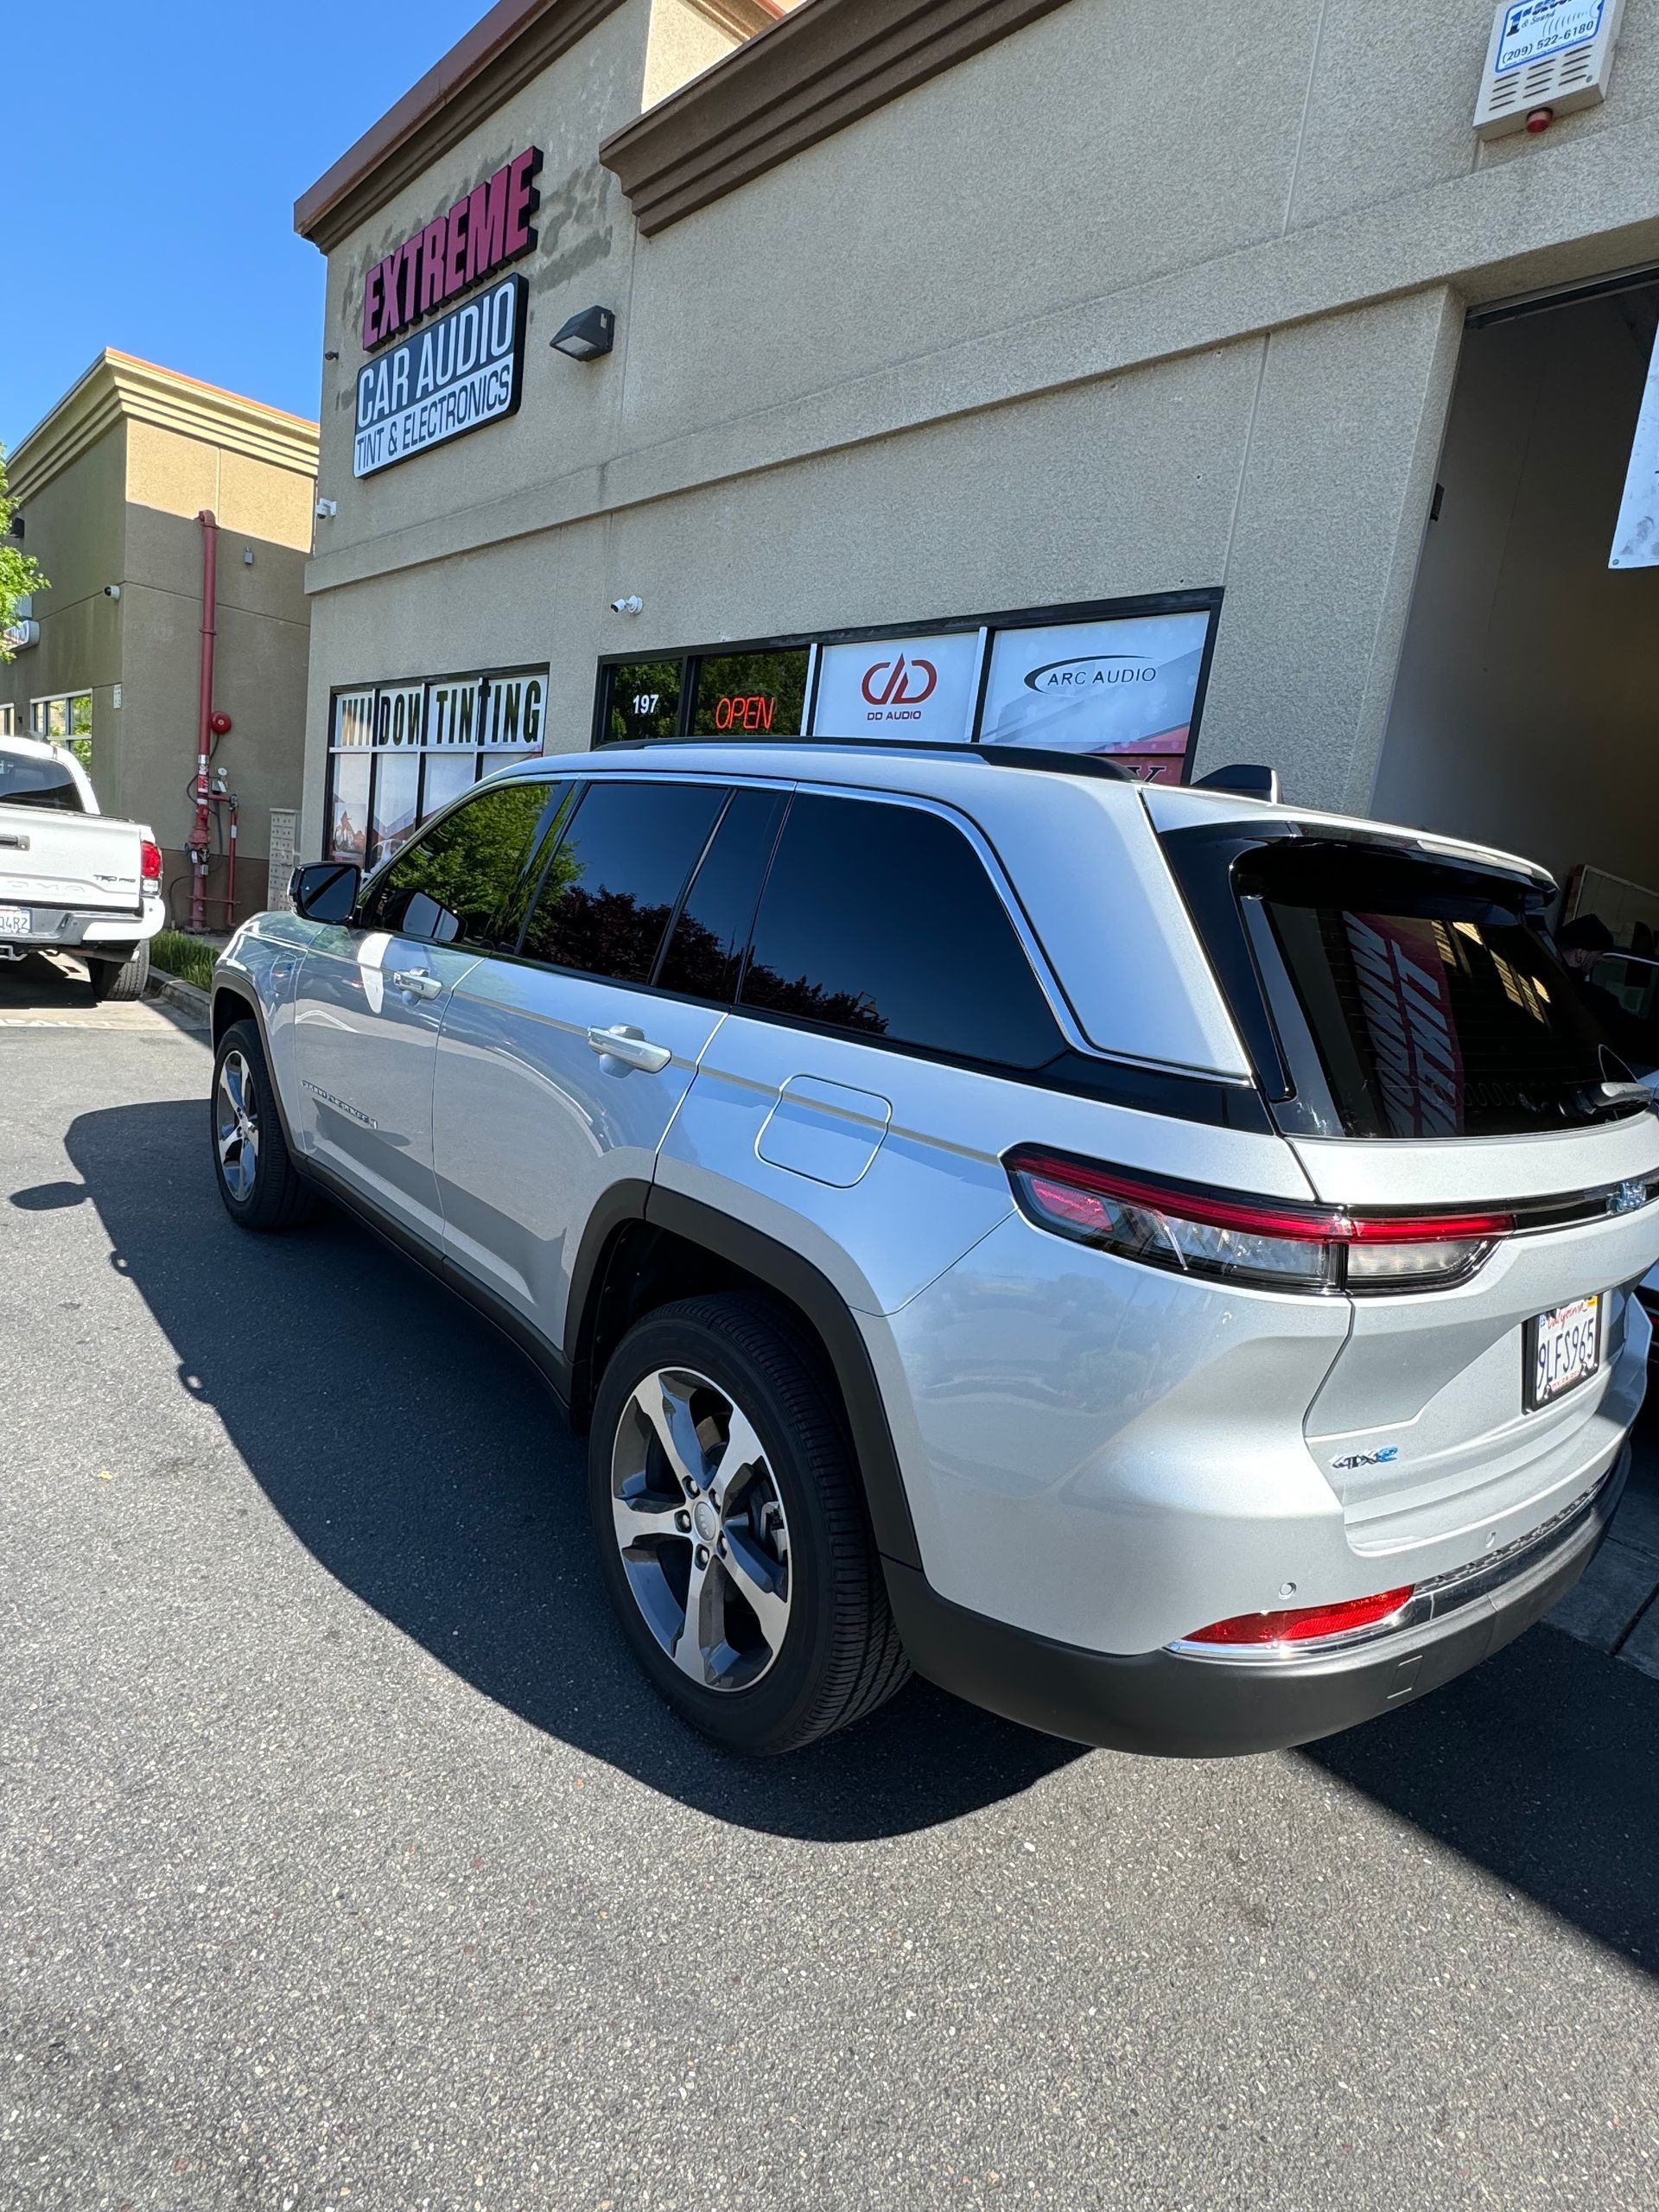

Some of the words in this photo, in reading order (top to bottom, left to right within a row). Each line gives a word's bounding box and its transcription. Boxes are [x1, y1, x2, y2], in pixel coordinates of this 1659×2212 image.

[1530, 10, 1557, 25] Sound
[1502, 43, 1533, 64] (209)
[1536, 20, 1594, 50] 522-6180
[362, 145, 537, 352] EXTREME
[358, 347, 410, 428] CAR
[416, 282, 515, 399] AUDIO
[357, 427, 385, 471] TINT
[388, 421, 397, 456] &
[403, 364, 511, 451] ELECTRONICS
[1047, 672, 1086, 686] ARC
[1092, 667, 1156, 685] AUDIO
[632, 694, 659, 715] 197
[715, 696, 775, 729] OPEN
[867, 712, 883, 721] DD
[886, 710, 922, 721] AUDIO
[1537, 1318, 1595, 1389] 9LFS965
